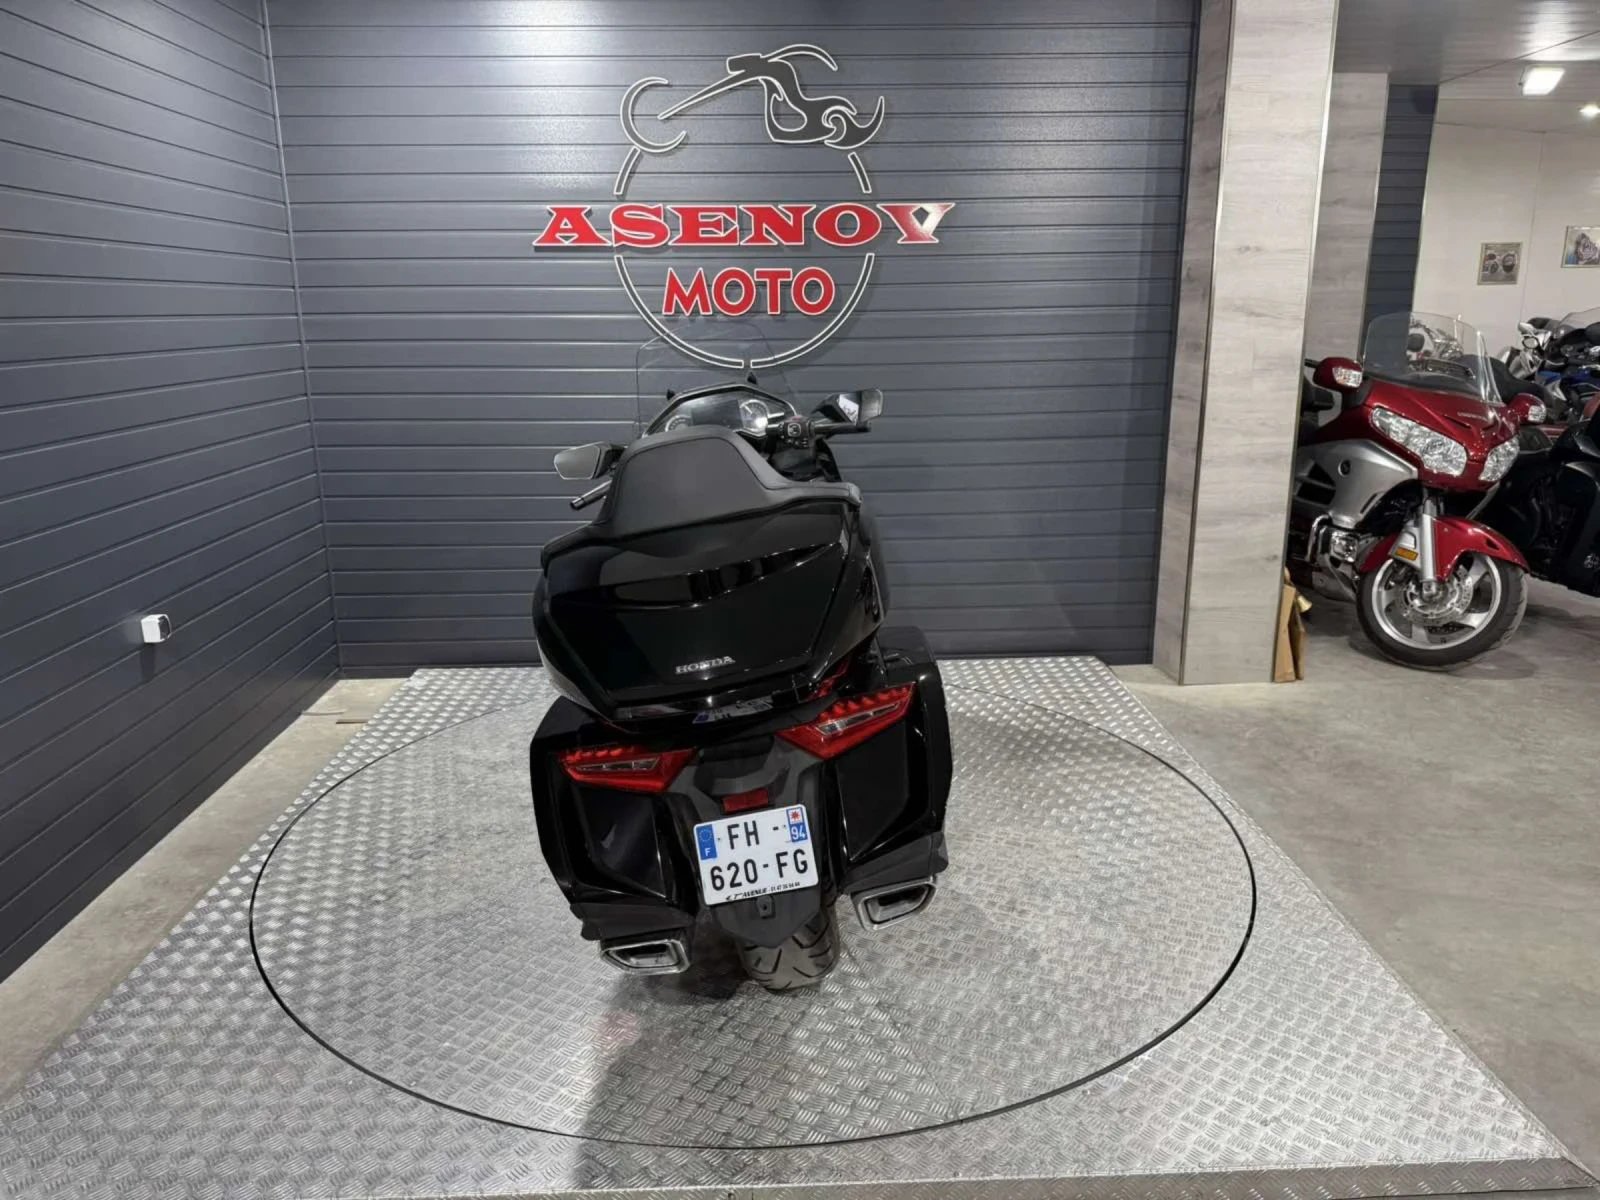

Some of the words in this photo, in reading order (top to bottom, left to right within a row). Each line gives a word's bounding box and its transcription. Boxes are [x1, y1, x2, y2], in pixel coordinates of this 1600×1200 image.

[533, 203, 955, 248] ASENOY
[662, 267, 835, 316] MOTO
[675, 656, 736, 674] HONDA
[727, 820, 760, 850] FH
[791, 825, 806, 840] 94
[704, 848, 711, 857] F
[710, 849, 808, 891] 620-FG
